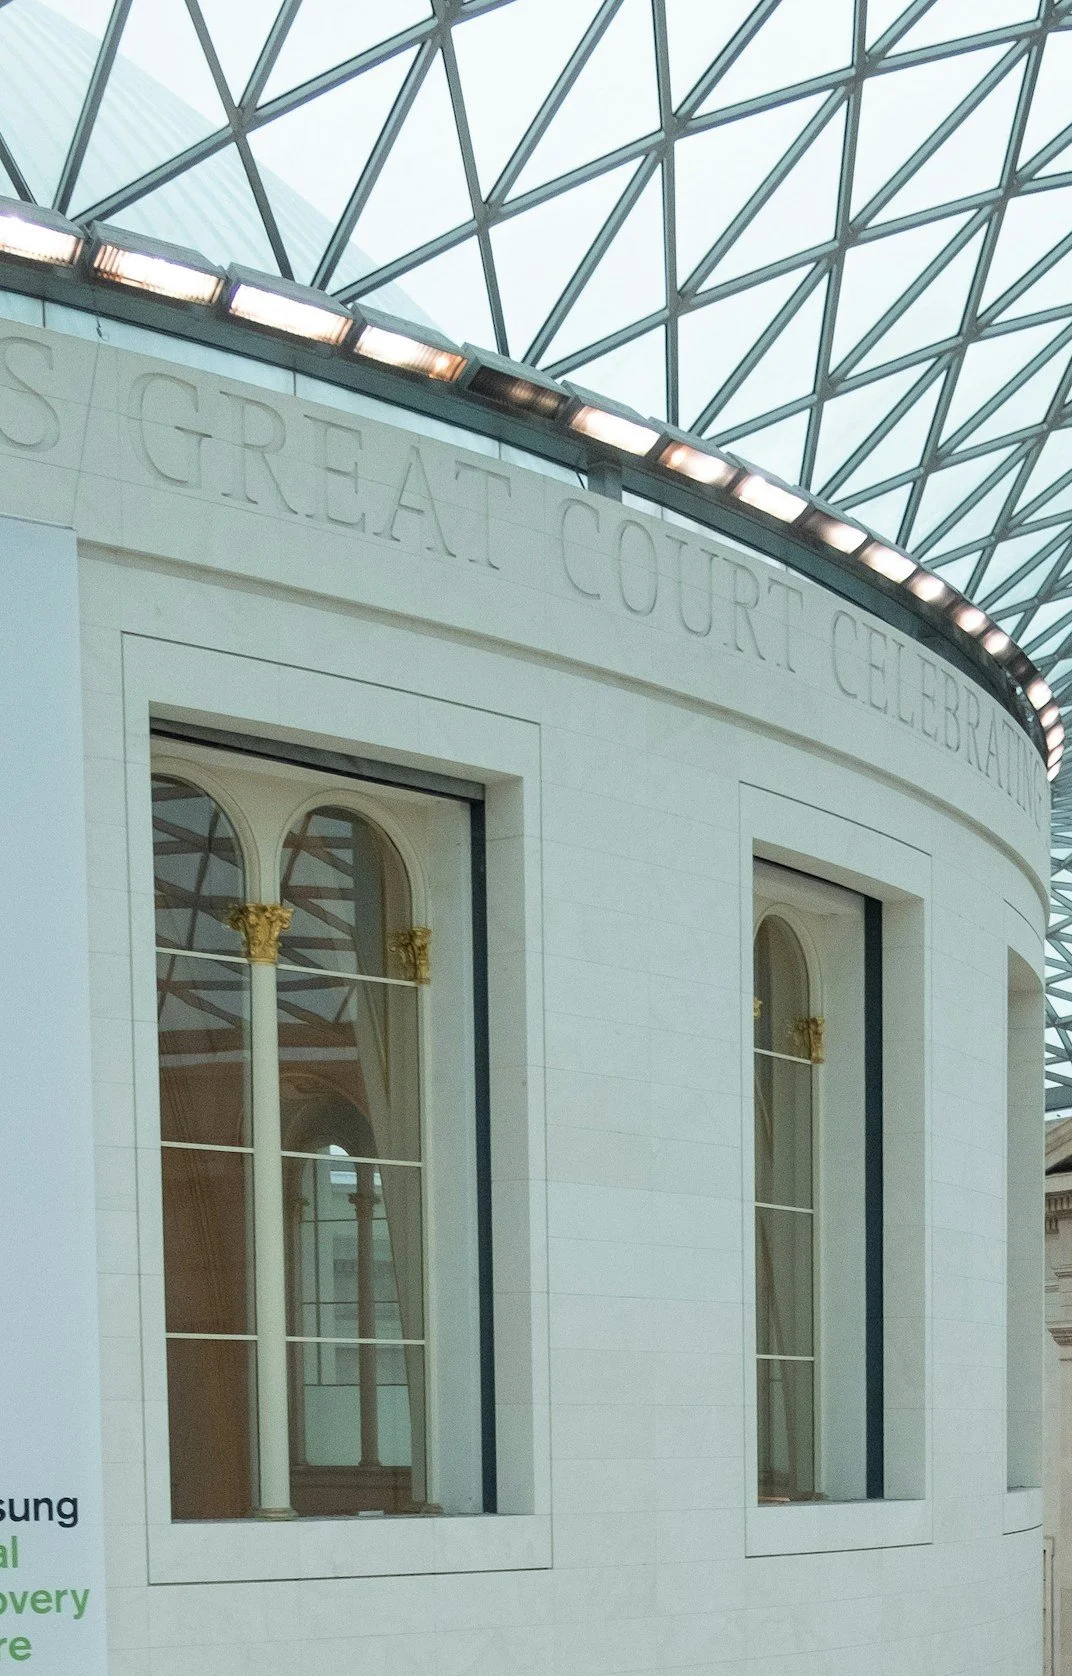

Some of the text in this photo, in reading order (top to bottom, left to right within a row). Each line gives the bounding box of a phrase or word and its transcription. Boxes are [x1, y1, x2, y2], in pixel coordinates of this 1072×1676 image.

[131, 371, 512, 572] GREAT
[561, 497, 804, 674] COURT
[831, 609, 1041, 832] CELEBRATING
